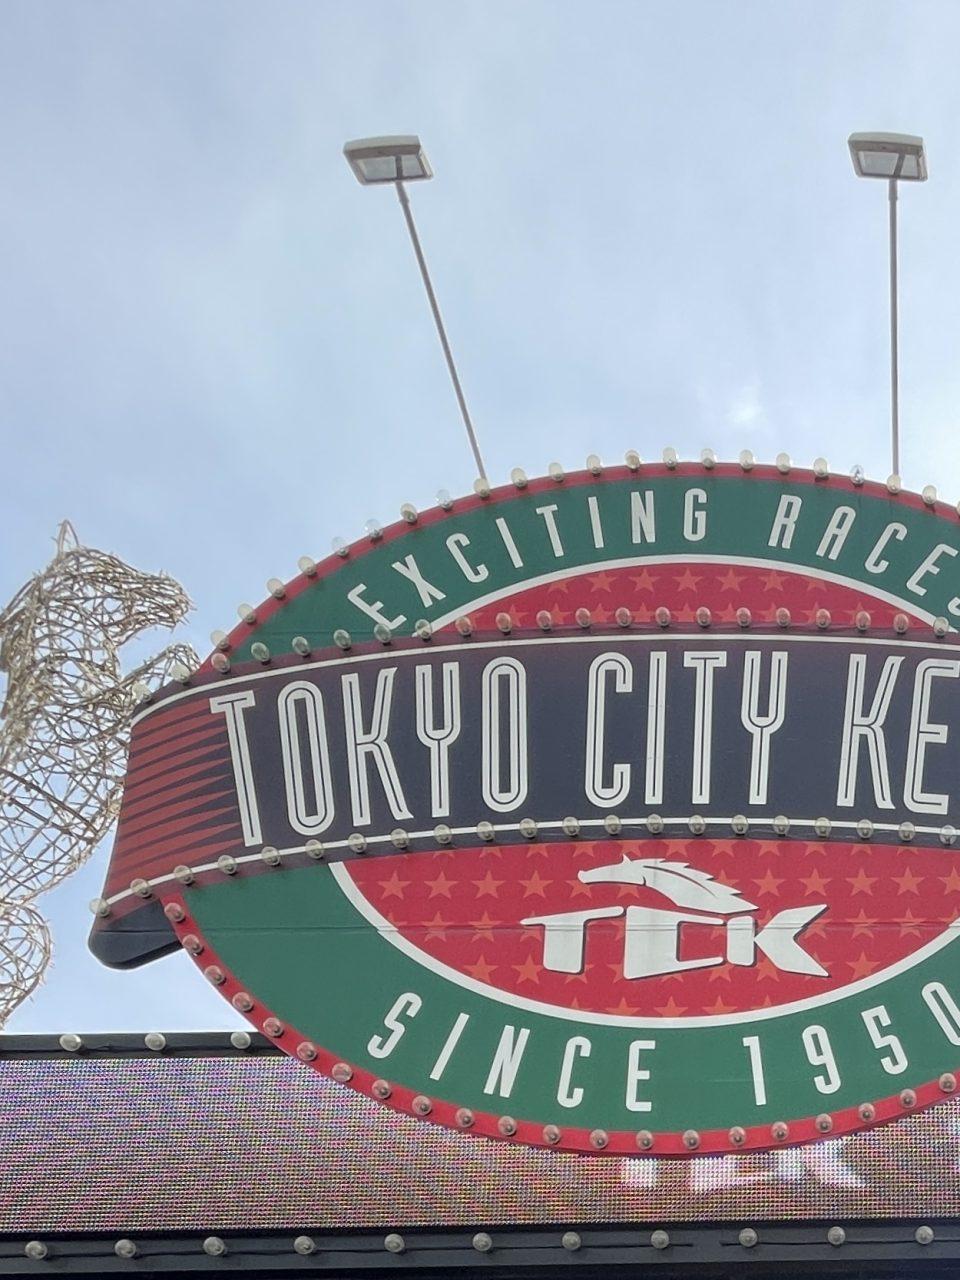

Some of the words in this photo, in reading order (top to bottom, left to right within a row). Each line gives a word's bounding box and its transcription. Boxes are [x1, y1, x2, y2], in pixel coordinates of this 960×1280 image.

[347, 487, 707, 633] EXCITING
[208, 655, 528, 847] TOKYO
[584, 650, 789, 808] CITY
[520, 904, 829, 979] TCK
[367, 992, 656, 1112] SINCE
